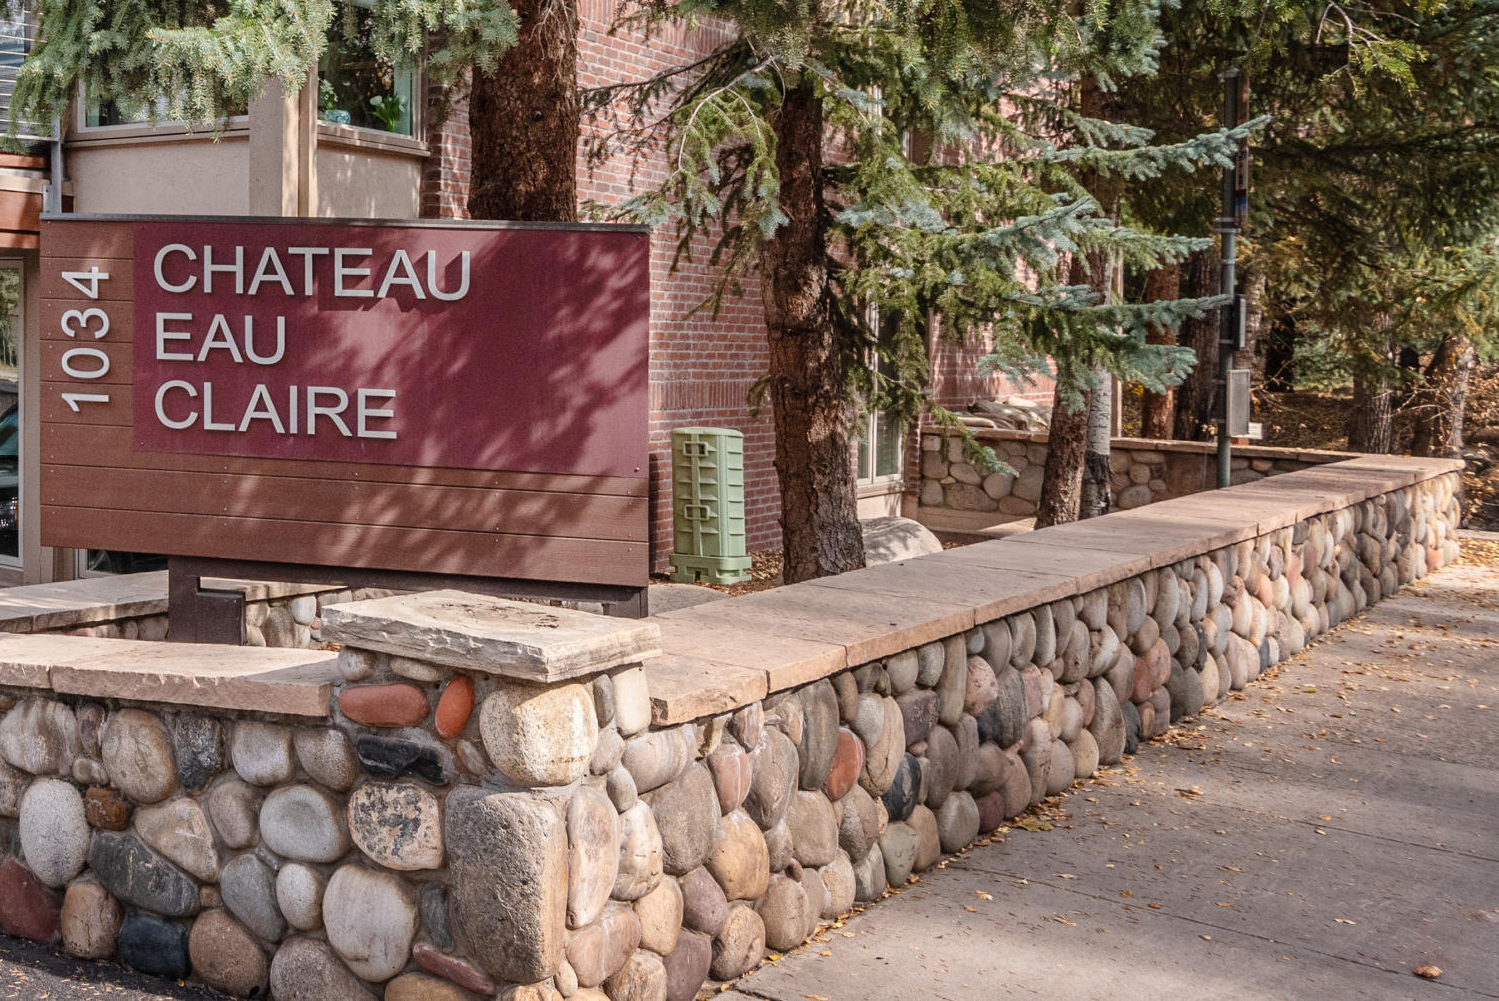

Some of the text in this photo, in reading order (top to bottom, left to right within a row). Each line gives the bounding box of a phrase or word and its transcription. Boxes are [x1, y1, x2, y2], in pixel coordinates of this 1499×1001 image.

[153, 243, 471, 301] CHATEAU
[60, 266, 111, 413] 1034
[154, 312, 287, 365] EAU
[154, 379, 398, 439] CLAIRE
